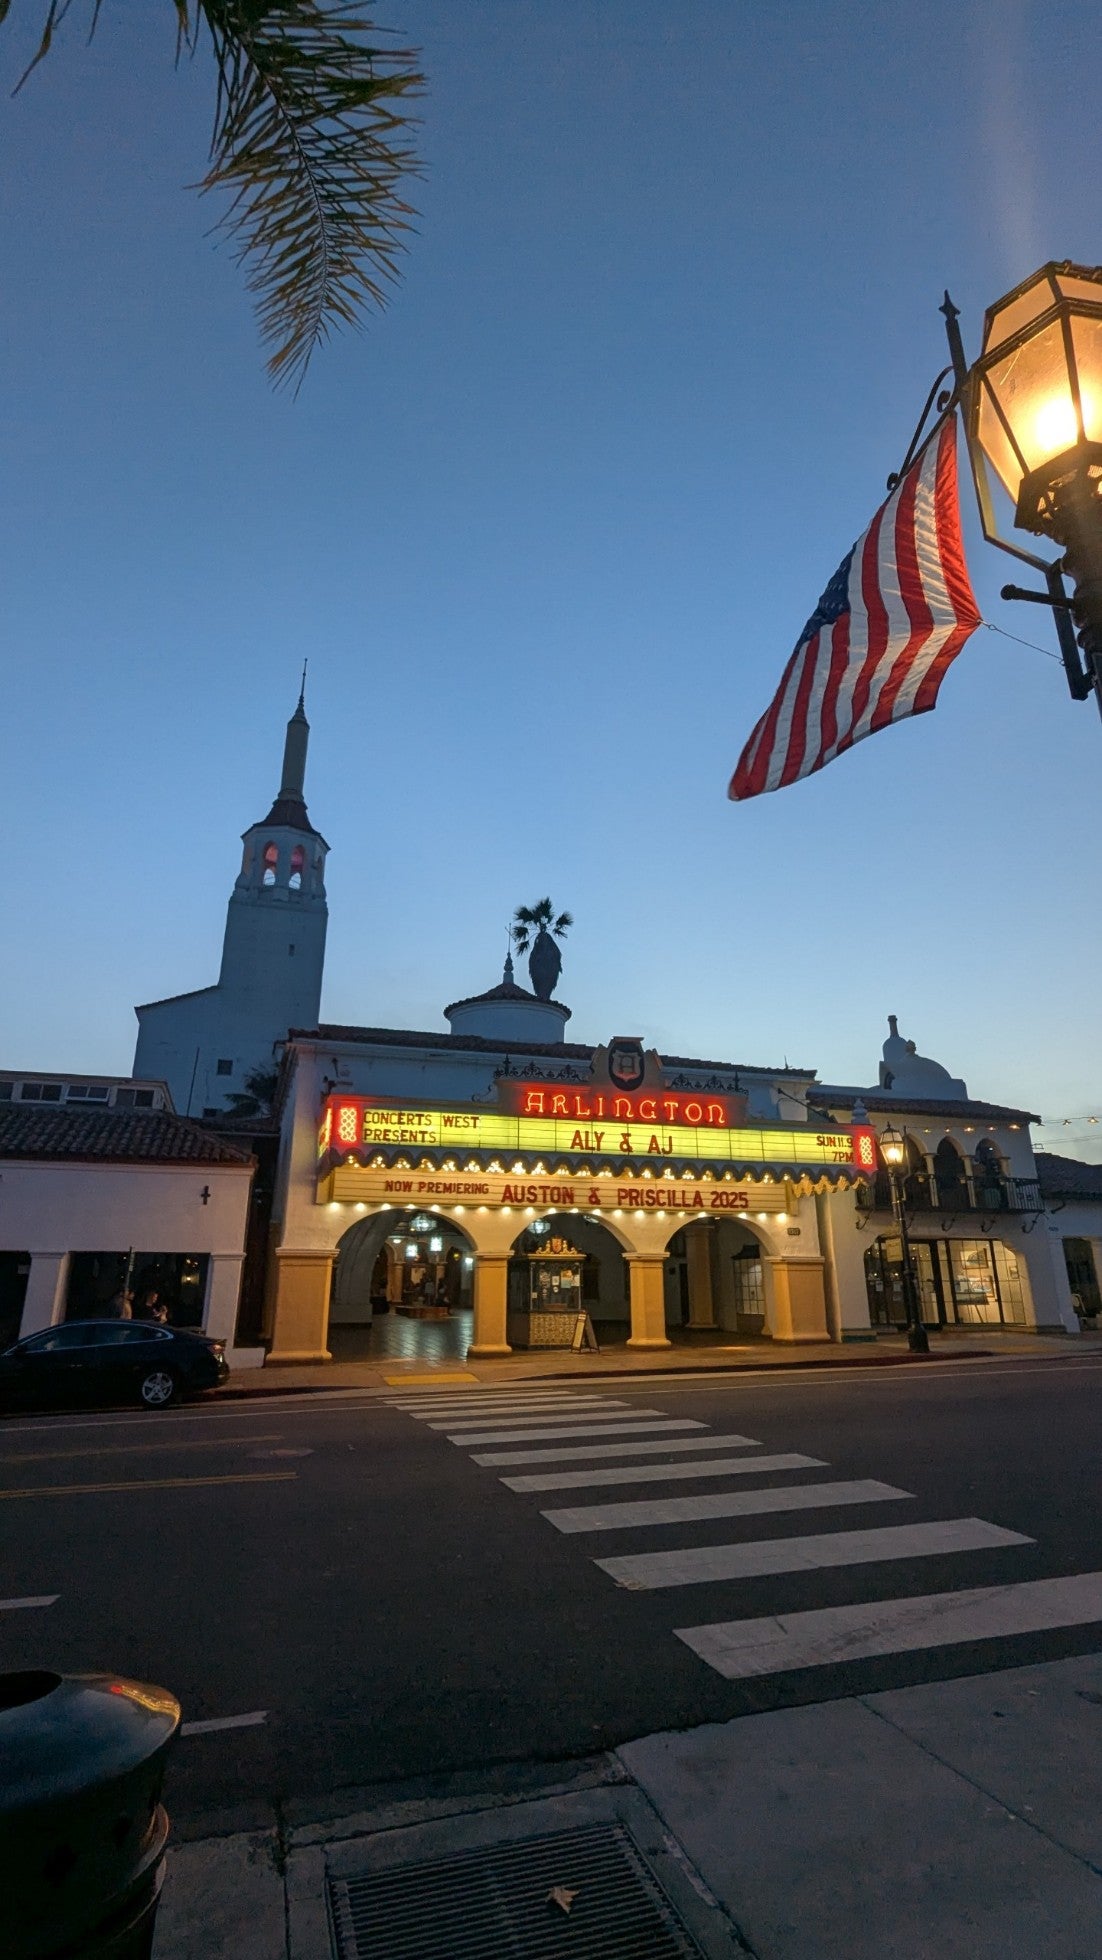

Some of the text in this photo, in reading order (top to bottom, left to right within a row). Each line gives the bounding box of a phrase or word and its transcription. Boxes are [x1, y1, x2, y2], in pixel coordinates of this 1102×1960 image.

[525, 1092, 725, 1124] ARLINGTON
[363, 1111, 479, 1129] CONCERTS WEST
[363, 1129, 437, 1144] PRESENTS
[570, 1130, 673, 1155] ALY & AJ
[832, 1151, 854, 1163] 7PM
[385, 1180, 749, 1209] NOW PREMIERING AUSTON & PRISCILLA 2025
